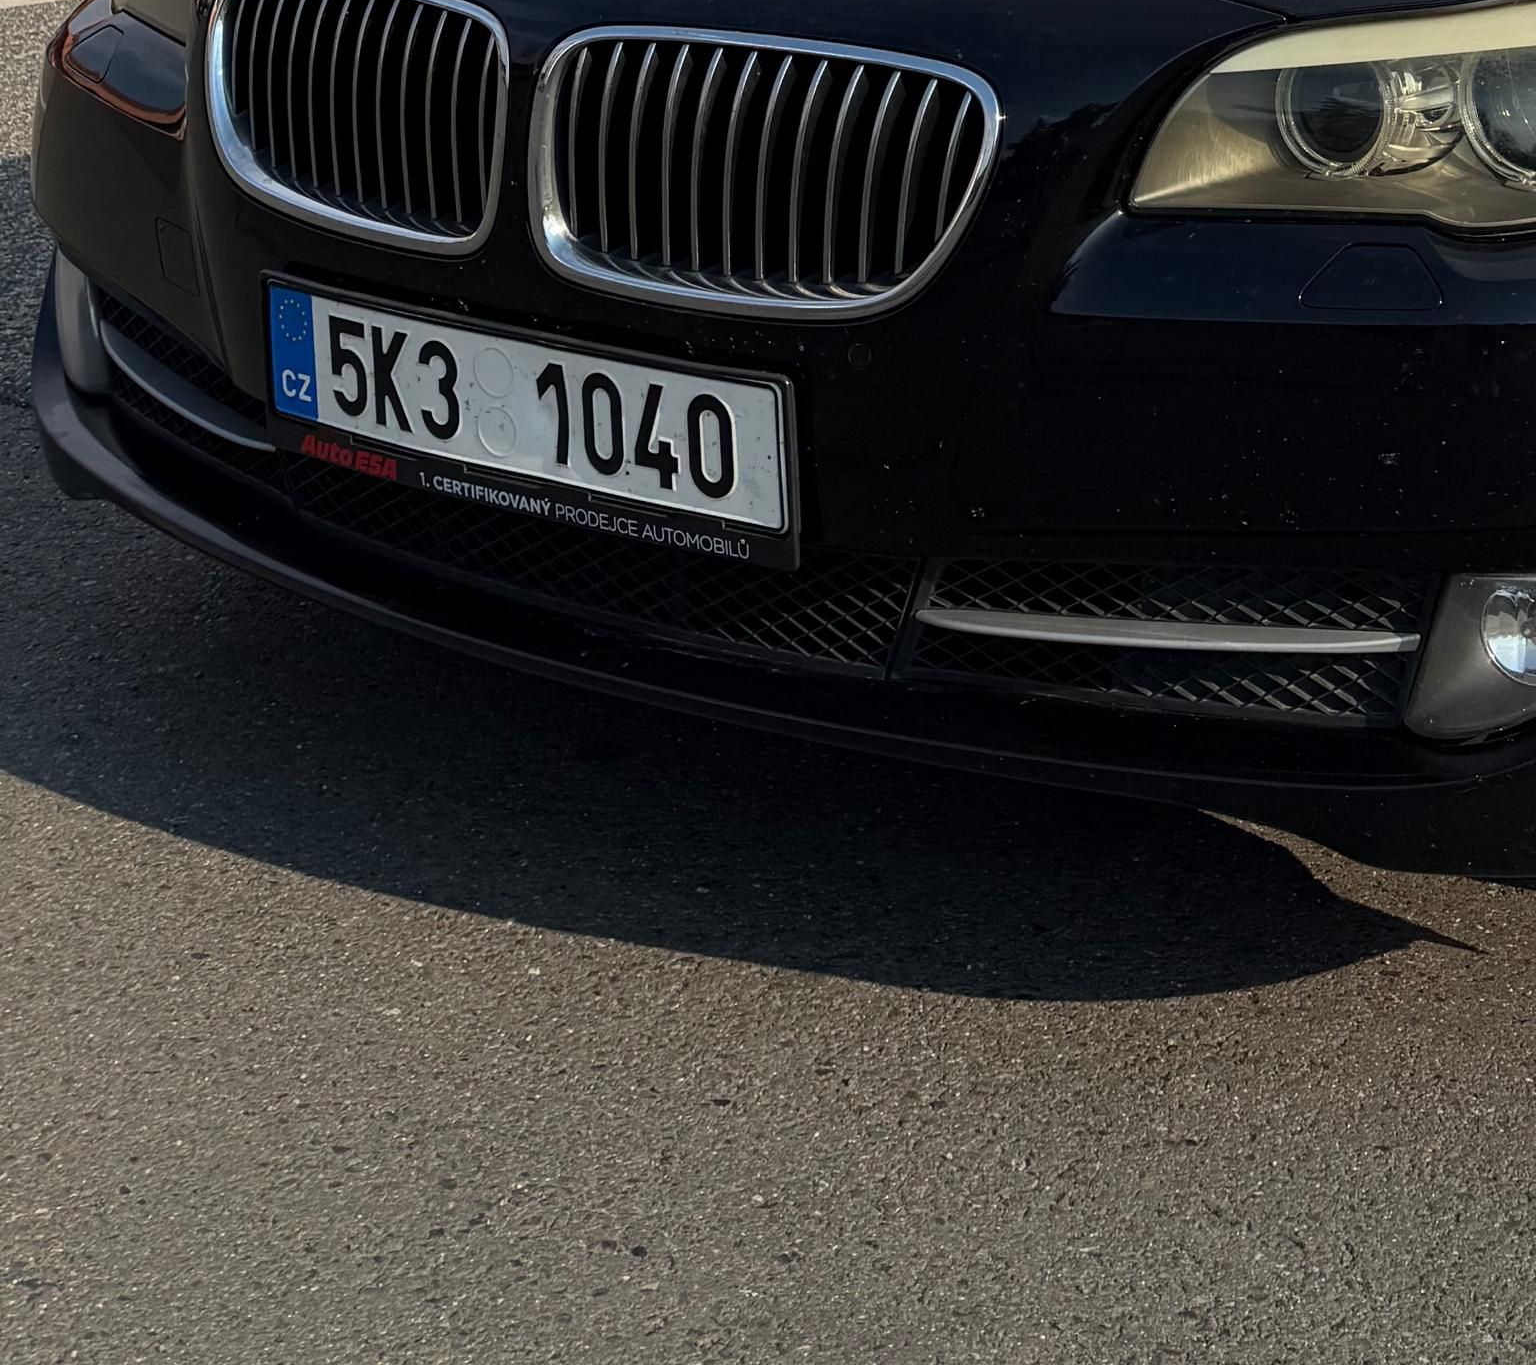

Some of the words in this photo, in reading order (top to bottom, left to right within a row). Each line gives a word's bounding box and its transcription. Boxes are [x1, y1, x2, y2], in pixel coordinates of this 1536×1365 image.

[281, 368, 313, 403] CZ
[328, 314, 461, 441] 5K3
[535, 362, 738, 499] 1040
[419, 471, 430, 488] 1.
[432, 475, 552, 517] CERTIFIKOVANÝ
[555, 502, 640, 537] PRODEJCE
[641, 523, 750, 560] AUTOMOBILŮ
